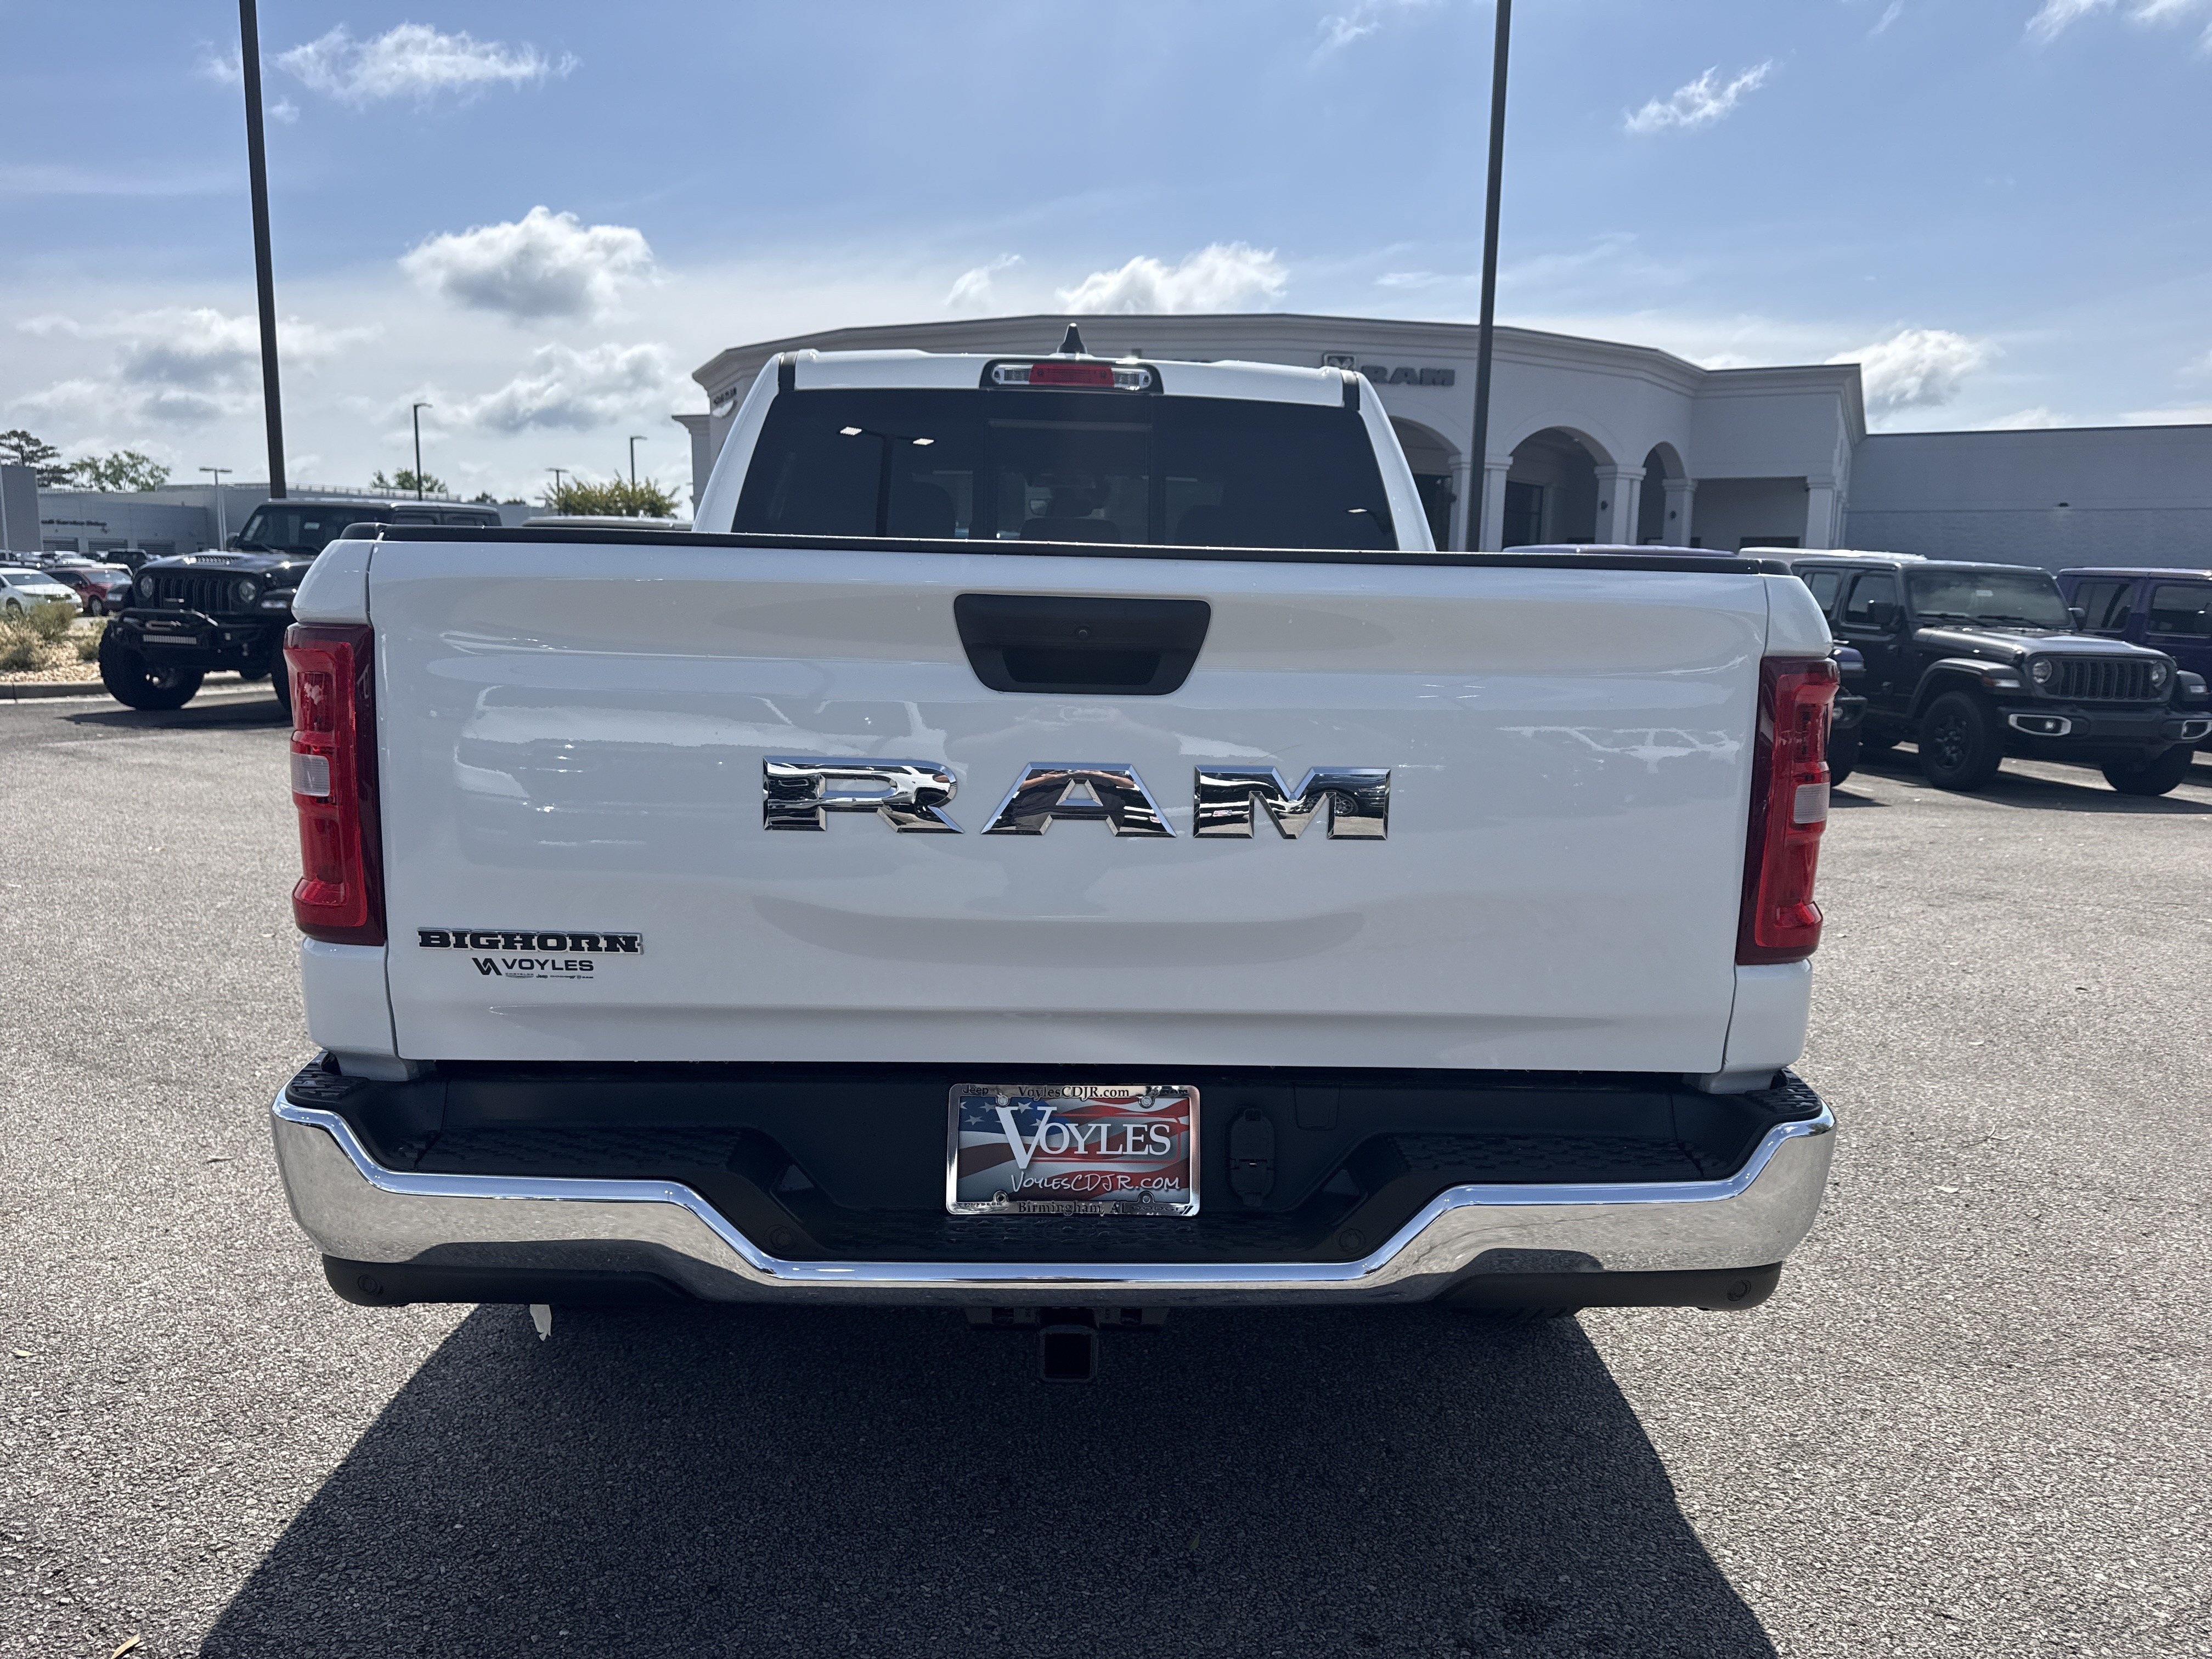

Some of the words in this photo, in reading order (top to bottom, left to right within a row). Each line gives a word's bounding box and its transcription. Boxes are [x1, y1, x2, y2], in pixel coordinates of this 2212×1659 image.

[1362, 365, 1455, 386] RAM
[763, 756, 1391, 840] RAM
[417, 928, 644, 955] BIGHORN
[501, 958, 594, 972] VOYLES
[962, 1084, 989, 1097] Jeep
[1017, 1085, 1130, 1102] VoylesCDJR.com
[995, 1106, 1171, 1169] VOYLES
[1018, 1201, 1105, 1217] Birmingham,
